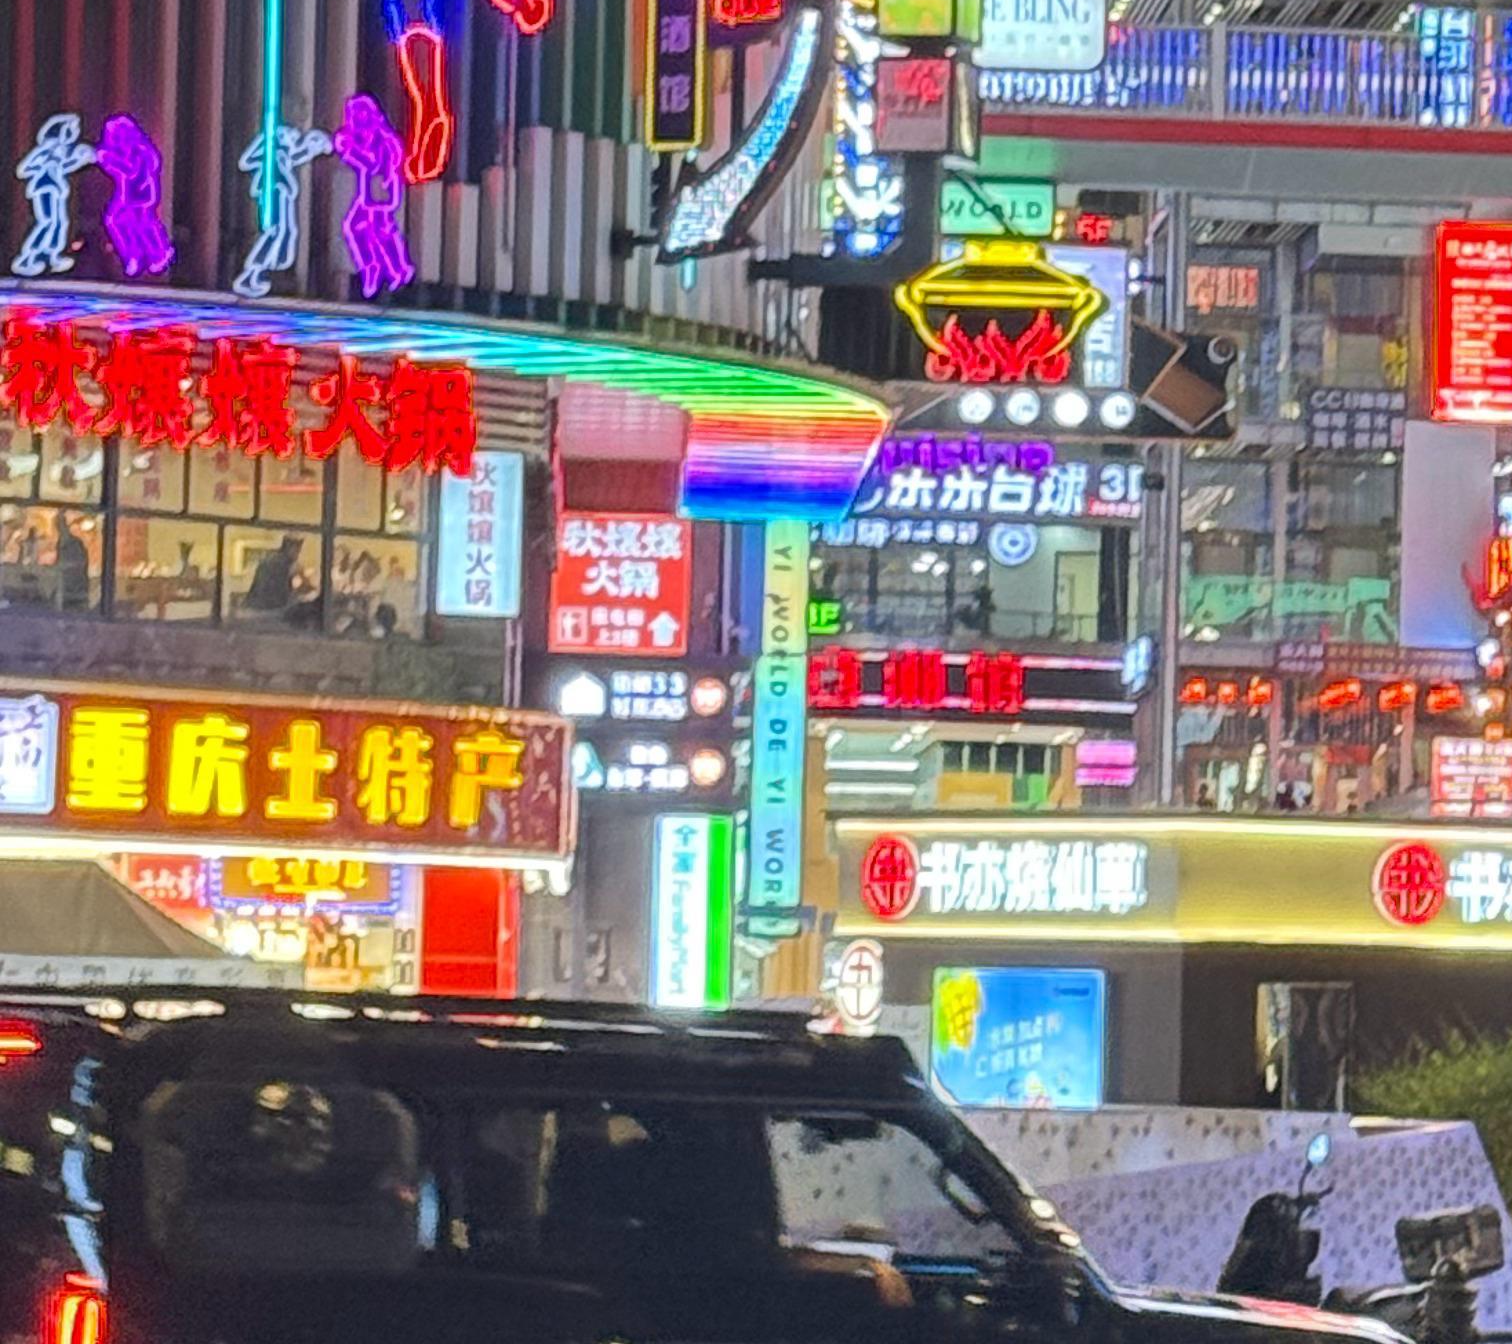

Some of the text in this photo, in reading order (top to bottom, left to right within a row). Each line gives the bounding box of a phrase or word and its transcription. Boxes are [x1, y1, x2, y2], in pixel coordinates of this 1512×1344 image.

[773, 545, 793, 571] YI
[768, 718, 787, 752] DE
[66, 706, 527, 829] 重庆土特产
[766, 778, 786, 804] YI
[918, 840, 1148, 914] 书亦烧仙草
